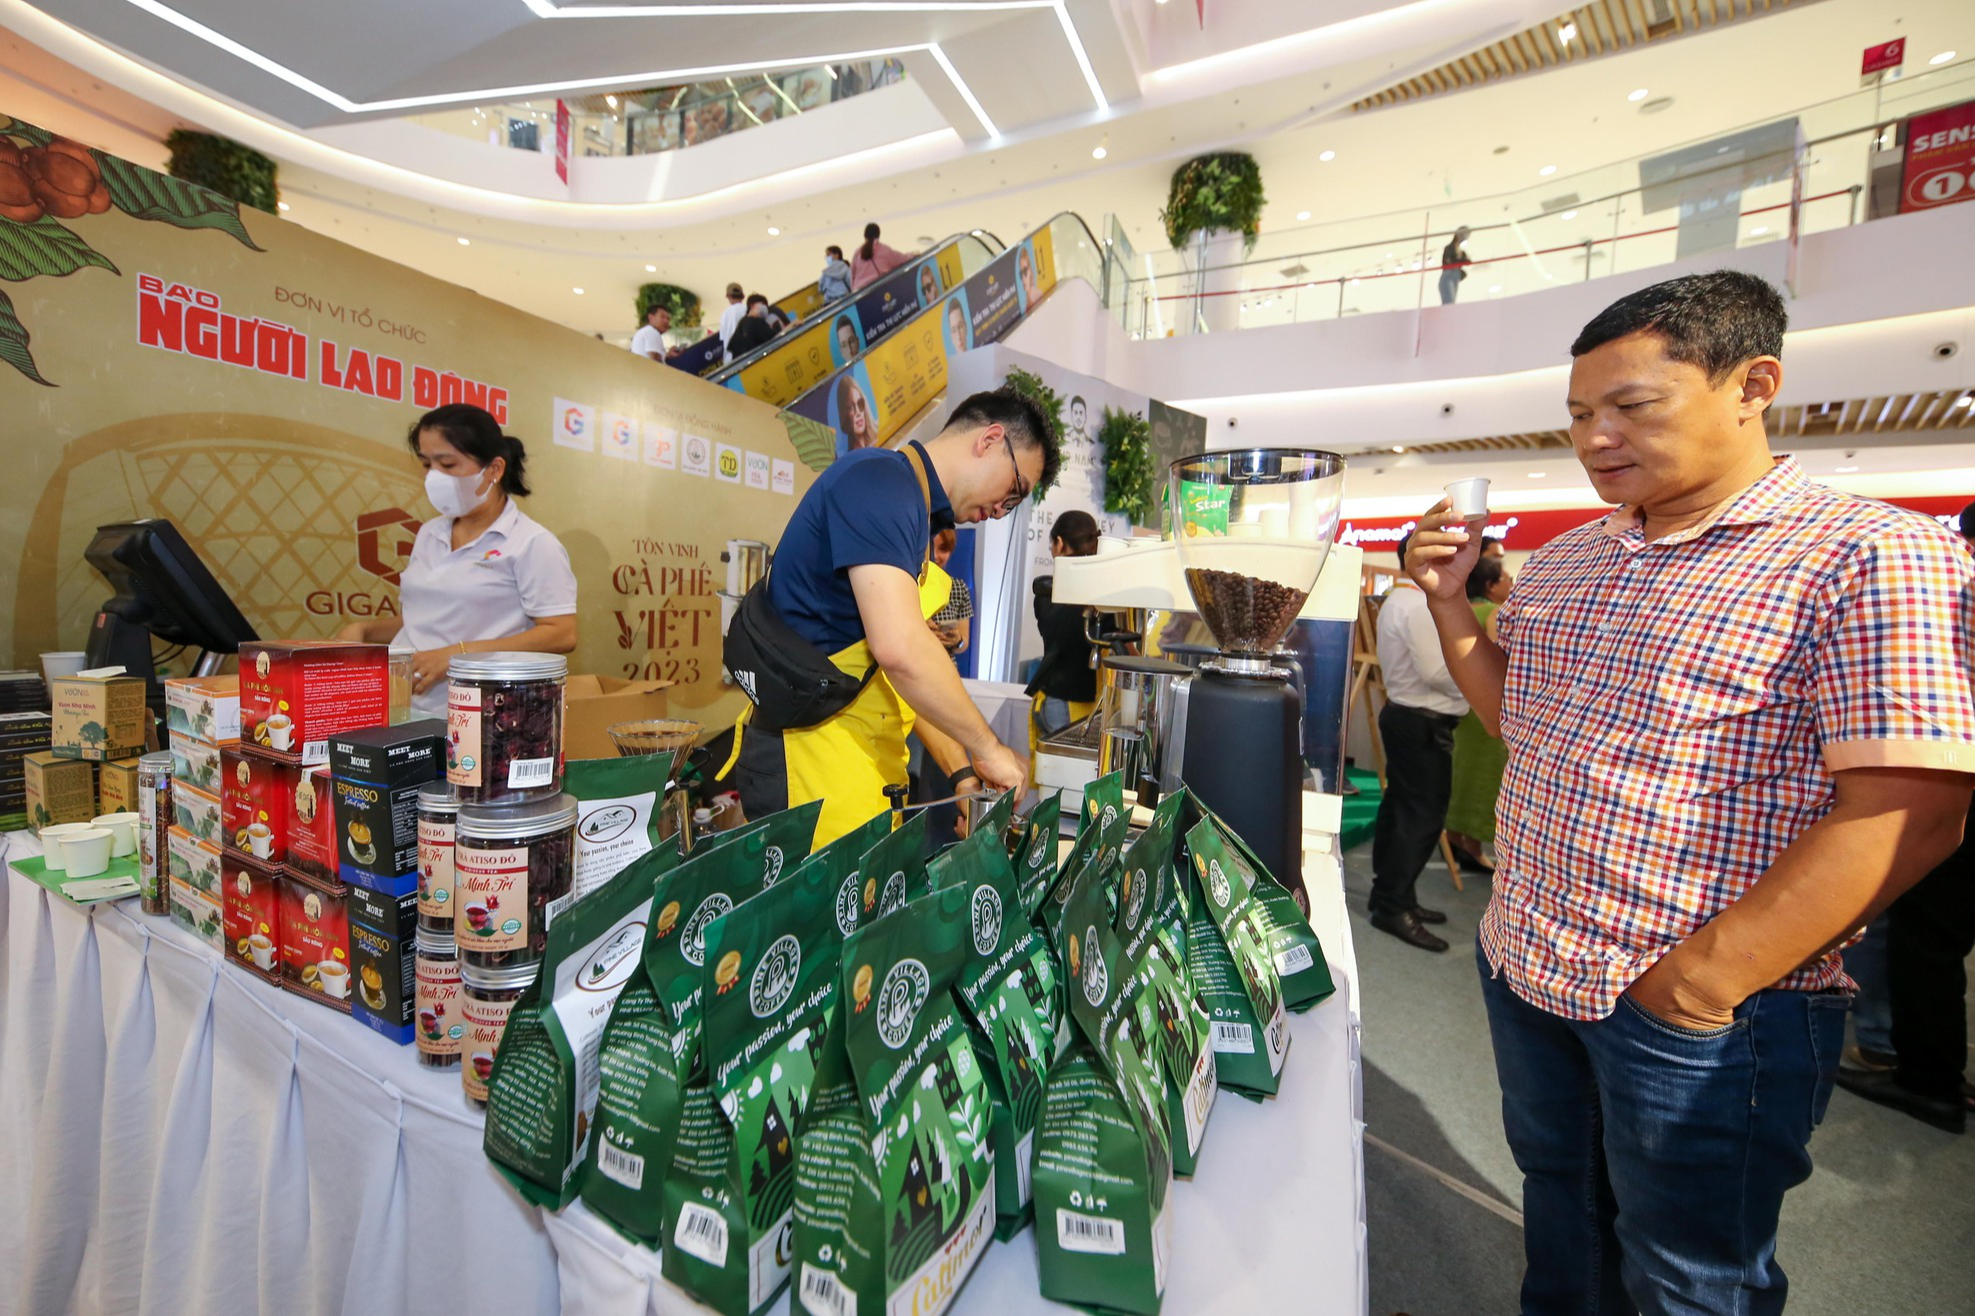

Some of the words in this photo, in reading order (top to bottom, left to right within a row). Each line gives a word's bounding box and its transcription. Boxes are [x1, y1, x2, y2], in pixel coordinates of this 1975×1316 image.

[138, 273, 220, 309] BÁO
[274, 286, 322, 312] ĐƠN
[328, 302, 347, 324] VỊ
[349, 306, 374, 328] TỔ
[378, 319, 427, 346] CHỨC
[320, 339, 403, 402] LAO
[1029, 510, 1053, 526] THE
[1028, 528, 1043, 542] OF
[632, 538, 664, 556] TÔN
[668, 542, 699, 559] VINH
[612, 558, 655, 596] CÀ
[661, 561, 712, 597] PHÊ
[612, 597, 712, 656] VIỆT
[734, 670, 760, 706] adidas
[336, 743, 354, 754] MEET
[388, 745, 410, 756] MEET
[408, 748, 431, 759] MORE
[350, 756, 370, 768] MORE
[337, 782, 378, 803] ESPRESSO
[469, 855, 497, 865] ATISO
[500, 853, 516, 864] ĐỎ
[580, 850, 591, 858] Your
[610, 843, 619, 852] your
[620, 839, 634, 848] choice
[354, 887, 370, 901] MEET
[462, 877, 490, 892] Minh
[491, 876, 516, 892] Trí
[366, 903, 384, 918] MORE
[400, 898, 418, 909] MEE
[977, 889, 1001, 913] VILLAGE
[352, 925, 390, 952] ESPRESSO
[979, 927, 999, 951] COFFEE
[603, 953, 618, 965] PINE
[618, 938, 643, 956] VILLAGE
[771, 940, 798, 964] VILLAGE
[420, 966, 442, 975] ATISO
[444, 964, 459, 974] ĐỎ
[755, 963, 768, 996] PINE
[893, 964, 925, 995] VILLAGE
[963, 982, 978, 1008] Your
[999, 947, 1014, 969] your
[1014, 932, 1034, 953] choice
[759, 980, 793, 1012] COFFEE
[880, 983, 892, 1021] PINE
[476, 1007, 503, 1016] ATISO
[588, 1002, 605, 1019] Your
[671, 993, 693, 1026] Your
[469, 1028, 497, 1043] Minh
[717, 1051, 743, 1088] Your
[745, 1020, 785, 1063] passion,
[786, 1002, 805, 1028] your
[807, 982, 833, 1008] choice
[887, 1012, 914, 1042] COFFEE
[868, 1084, 889, 1126] Your
[888, 1053, 915, 1099] passion,
[913, 1035, 929, 1064] your
[929, 1014, 954, 1042] choice
